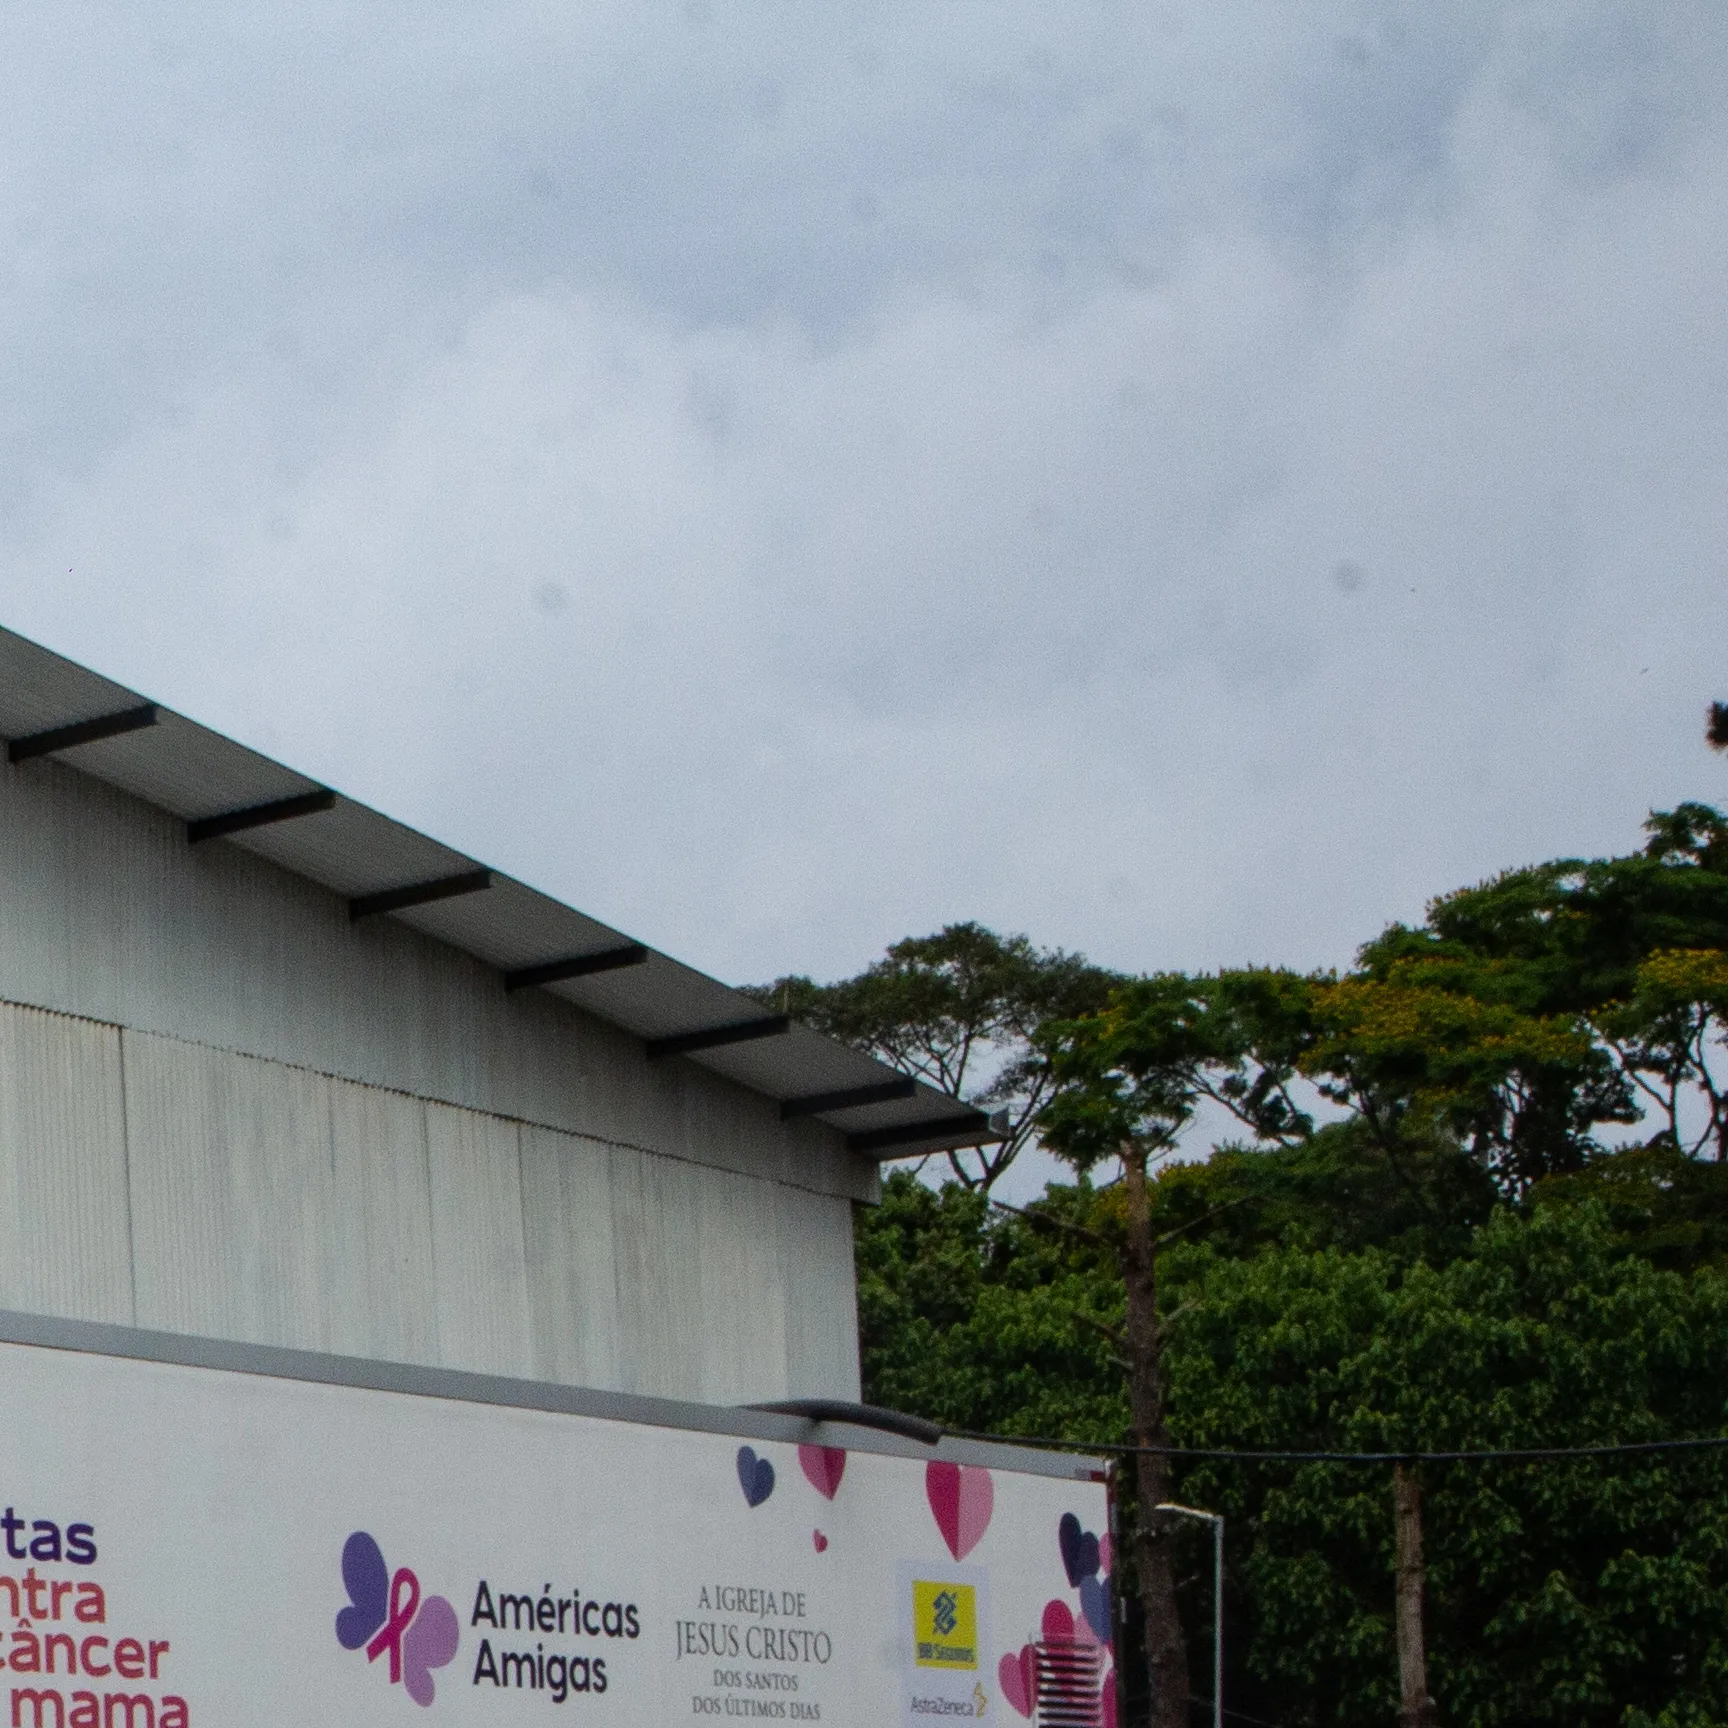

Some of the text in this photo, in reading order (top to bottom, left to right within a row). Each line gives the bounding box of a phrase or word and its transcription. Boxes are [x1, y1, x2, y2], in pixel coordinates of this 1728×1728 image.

[471, 1580, 640, 1639] Américas
[698, 1585, 806, 1618] A IGREJA DE
[676, 1621, 832, 1663] JESUS CRISTO
[473, 1639, 608, 1703] Amigas
[713, 1669, 798, 1691] DOS SANTOS
[692, 1694, 821, 1720] DOS ÚLTIMOS DIAS
[911, 1697, 974, 1716] AstraZeneca
